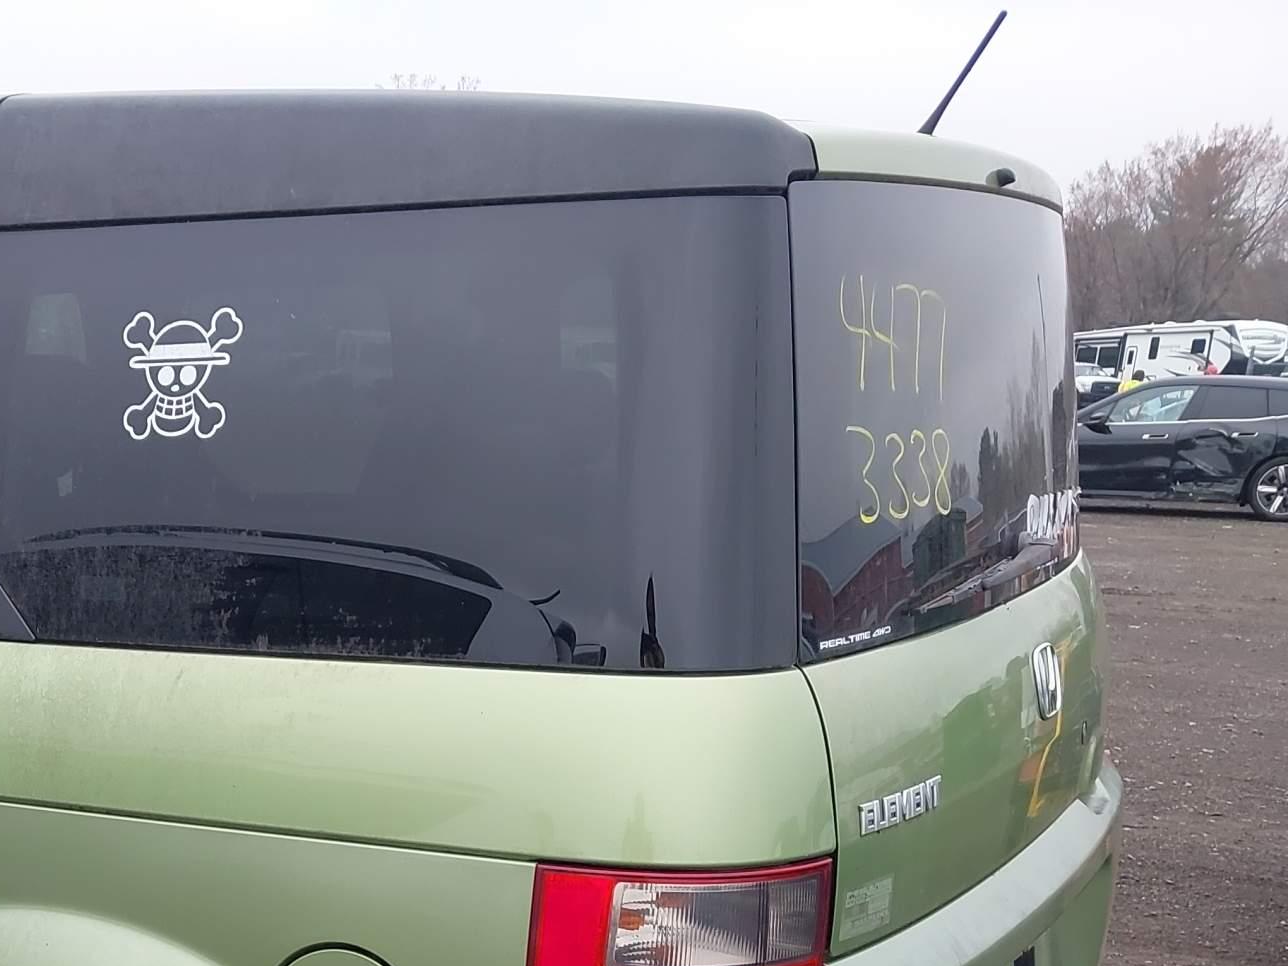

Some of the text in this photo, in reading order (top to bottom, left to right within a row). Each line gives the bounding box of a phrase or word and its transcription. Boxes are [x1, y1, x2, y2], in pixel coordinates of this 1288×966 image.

[840, 272, 946, 401] 4477
[845, 426, 953, 524] 3338
[819, 631, 871, 650] REALTIME
[859, 775, 942, 837] ELEMENT
